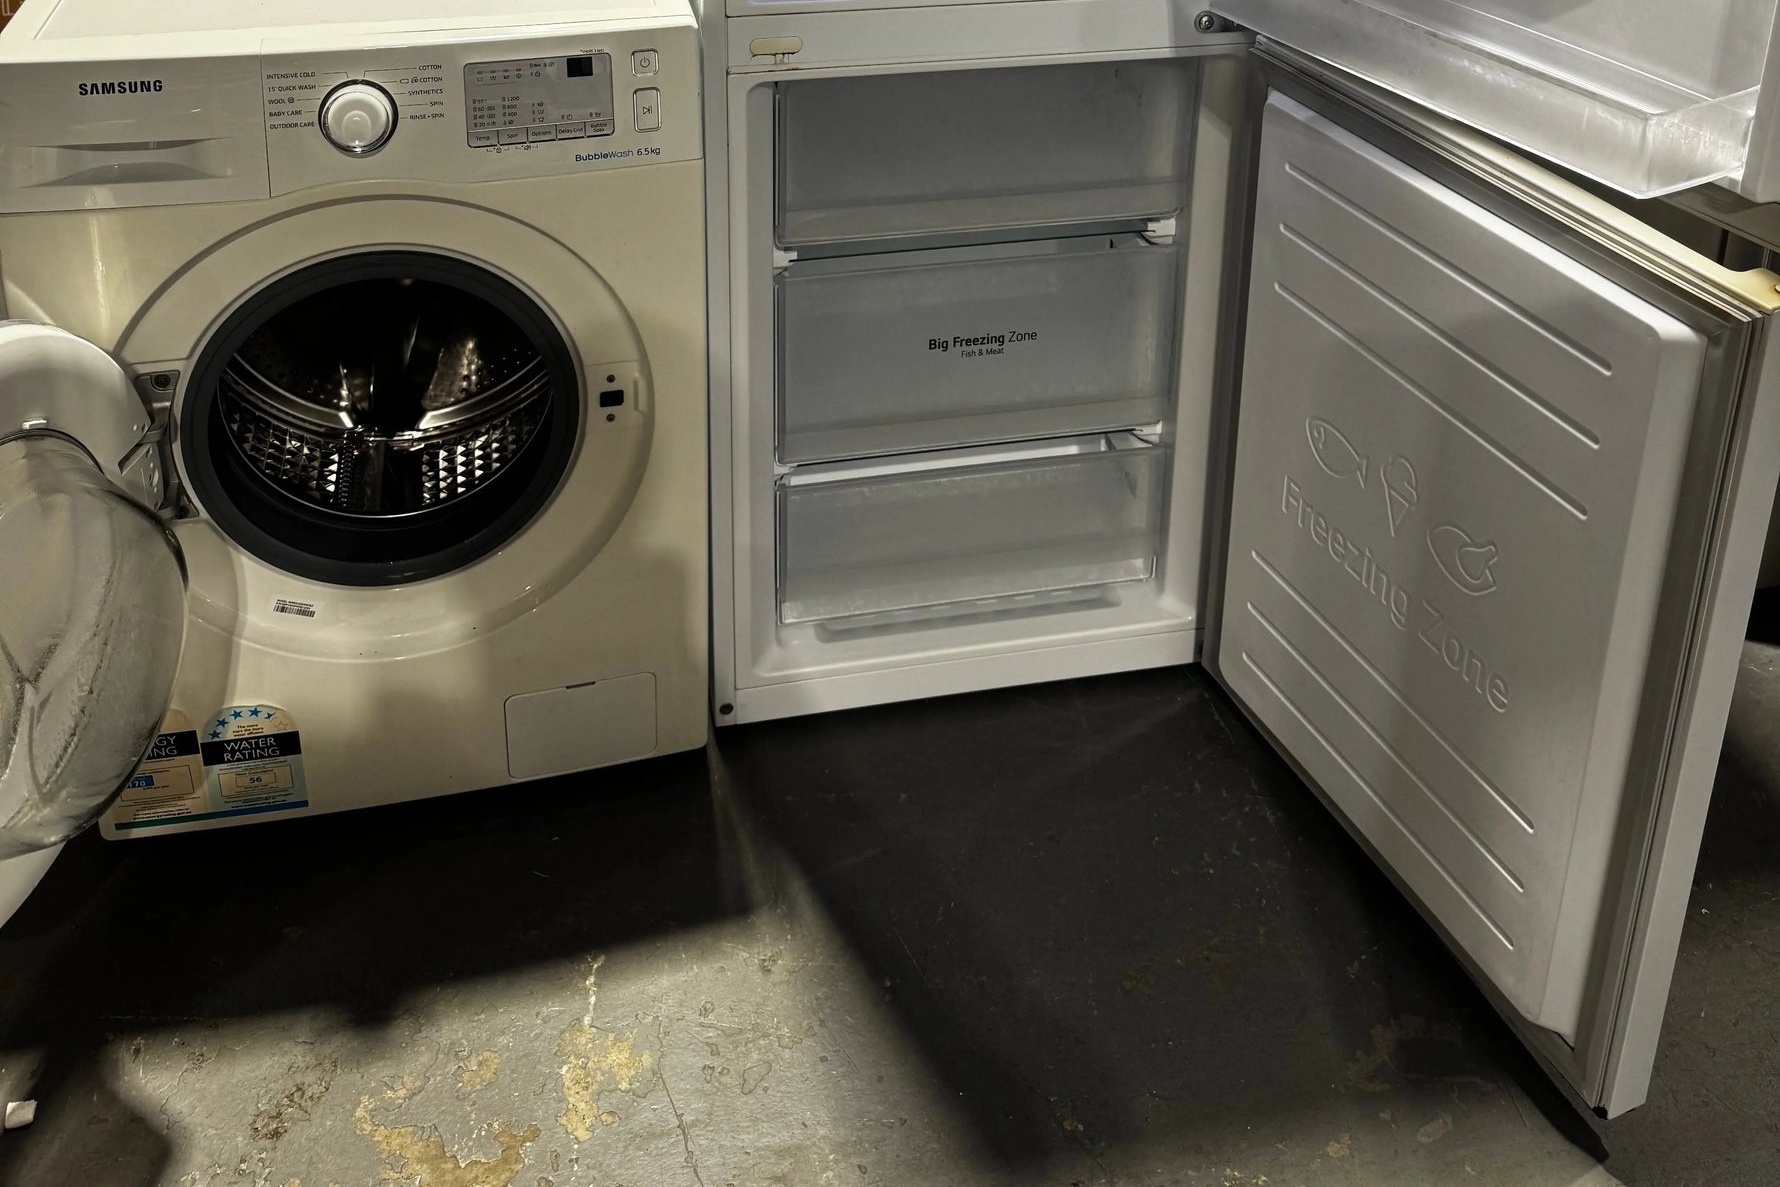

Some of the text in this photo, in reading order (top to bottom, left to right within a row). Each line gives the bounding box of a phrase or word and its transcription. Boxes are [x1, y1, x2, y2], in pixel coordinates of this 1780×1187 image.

[266, 72, 299, 80] INTENSIVE
[78, 80, 163, 96] SAMSUNG
[408, 88, 443, 96] SYNTHETICS
[270, 122, 298, 130] OUTDOOR
[575, 150, 634, 162] BubbleWash
[928, 331, 1038, 352] Big Freezing Zone
[961, 348, 1004, 358] Fish & Meat
[1281, 474, 1508, 713] Freezing Zone
[156, 735, 176, 746] GY
[224, 737, 276, 751] WATER
[224, 746, 280, 762] RATING
[249, 776, 262, 784] 56
